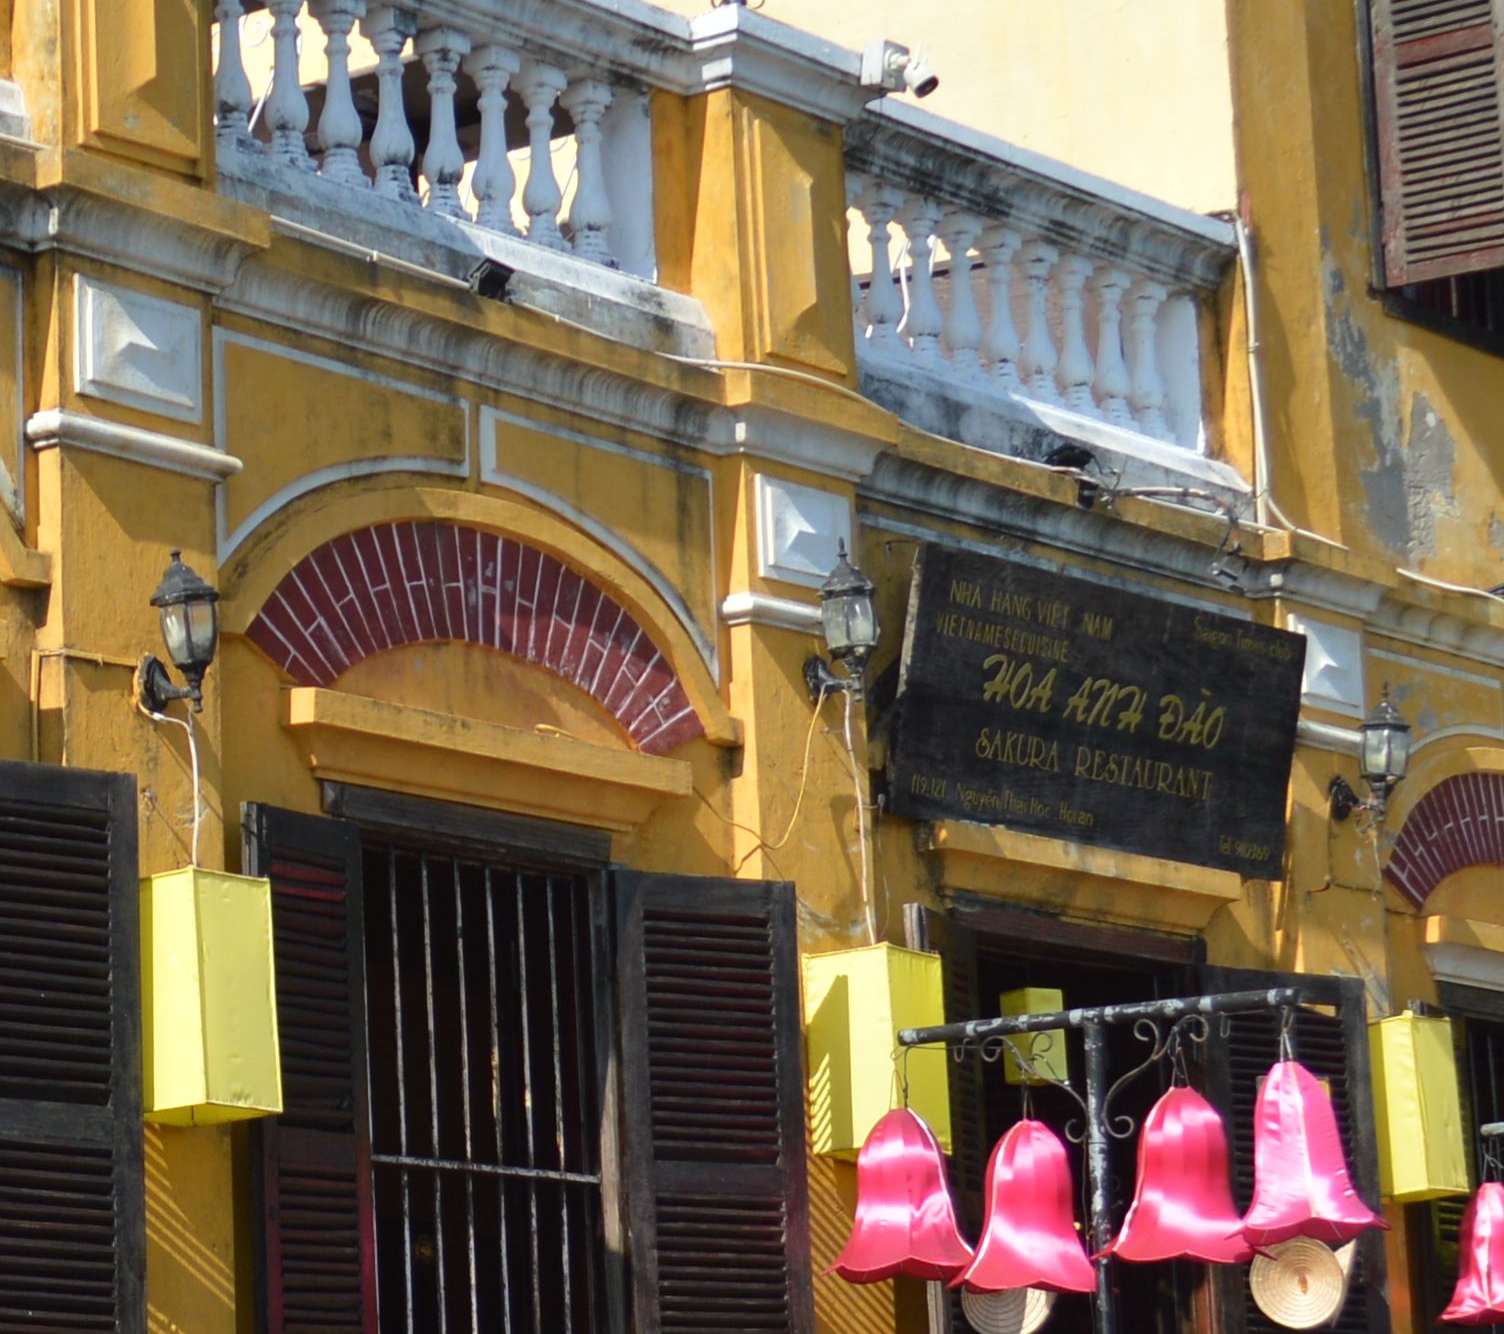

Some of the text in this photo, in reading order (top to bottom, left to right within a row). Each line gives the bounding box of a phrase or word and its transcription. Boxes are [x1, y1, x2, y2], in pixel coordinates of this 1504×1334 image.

[1083, 613, 1113, 641] NAM
[982, 653, 1057, 713] HOA
[1064, 675, 1148, 734] ANH
[975, 727, 1214, 801] SAKURA RESTAURANT
